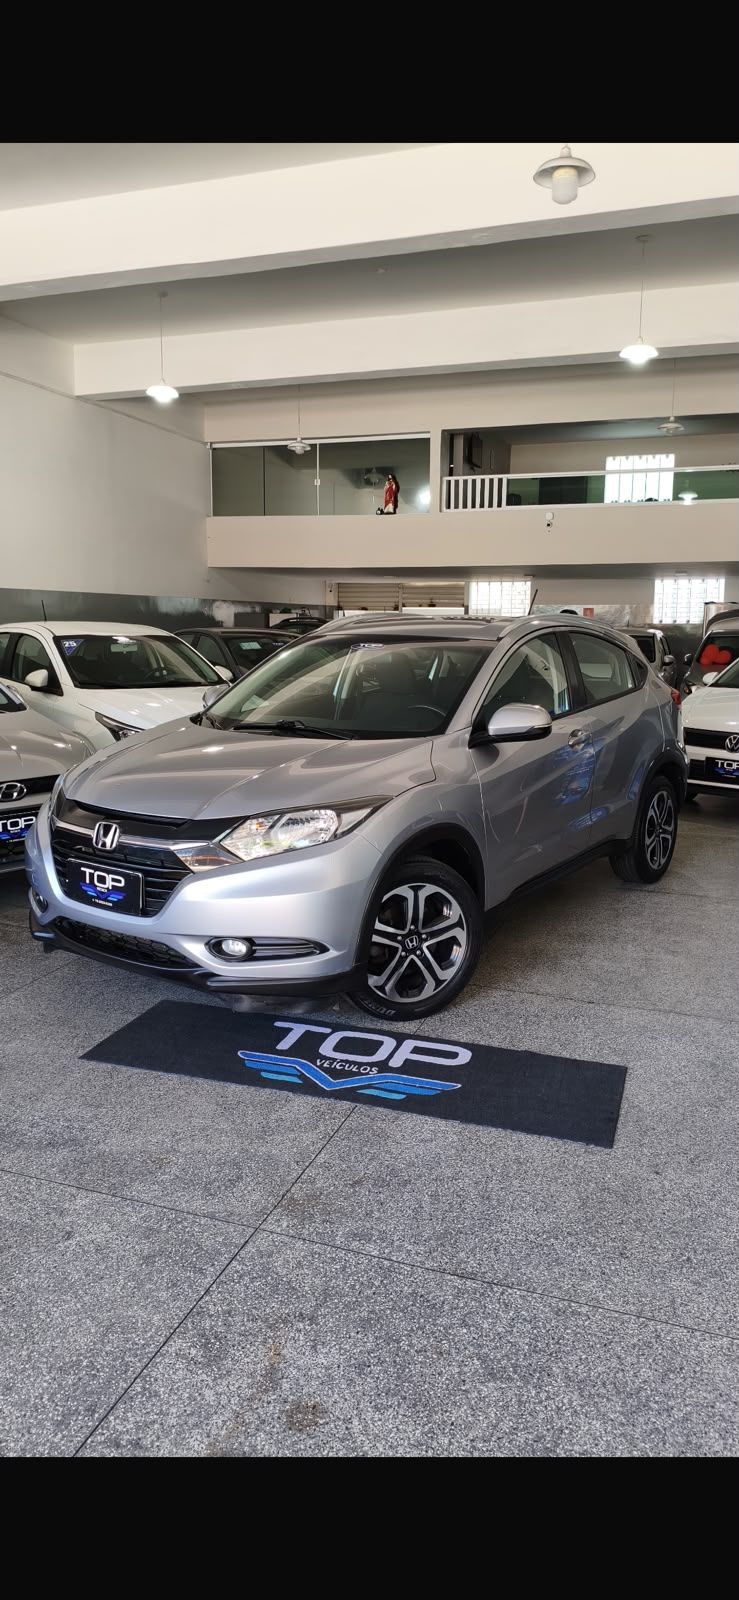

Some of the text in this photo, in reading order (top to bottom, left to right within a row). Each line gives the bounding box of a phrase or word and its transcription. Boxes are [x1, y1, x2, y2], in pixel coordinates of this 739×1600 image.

[81, 867, 125, 890] TOP
[273, 1021, 473, 1068] TOP
[316, 1058, 379, 1075] VEÍCULOS
